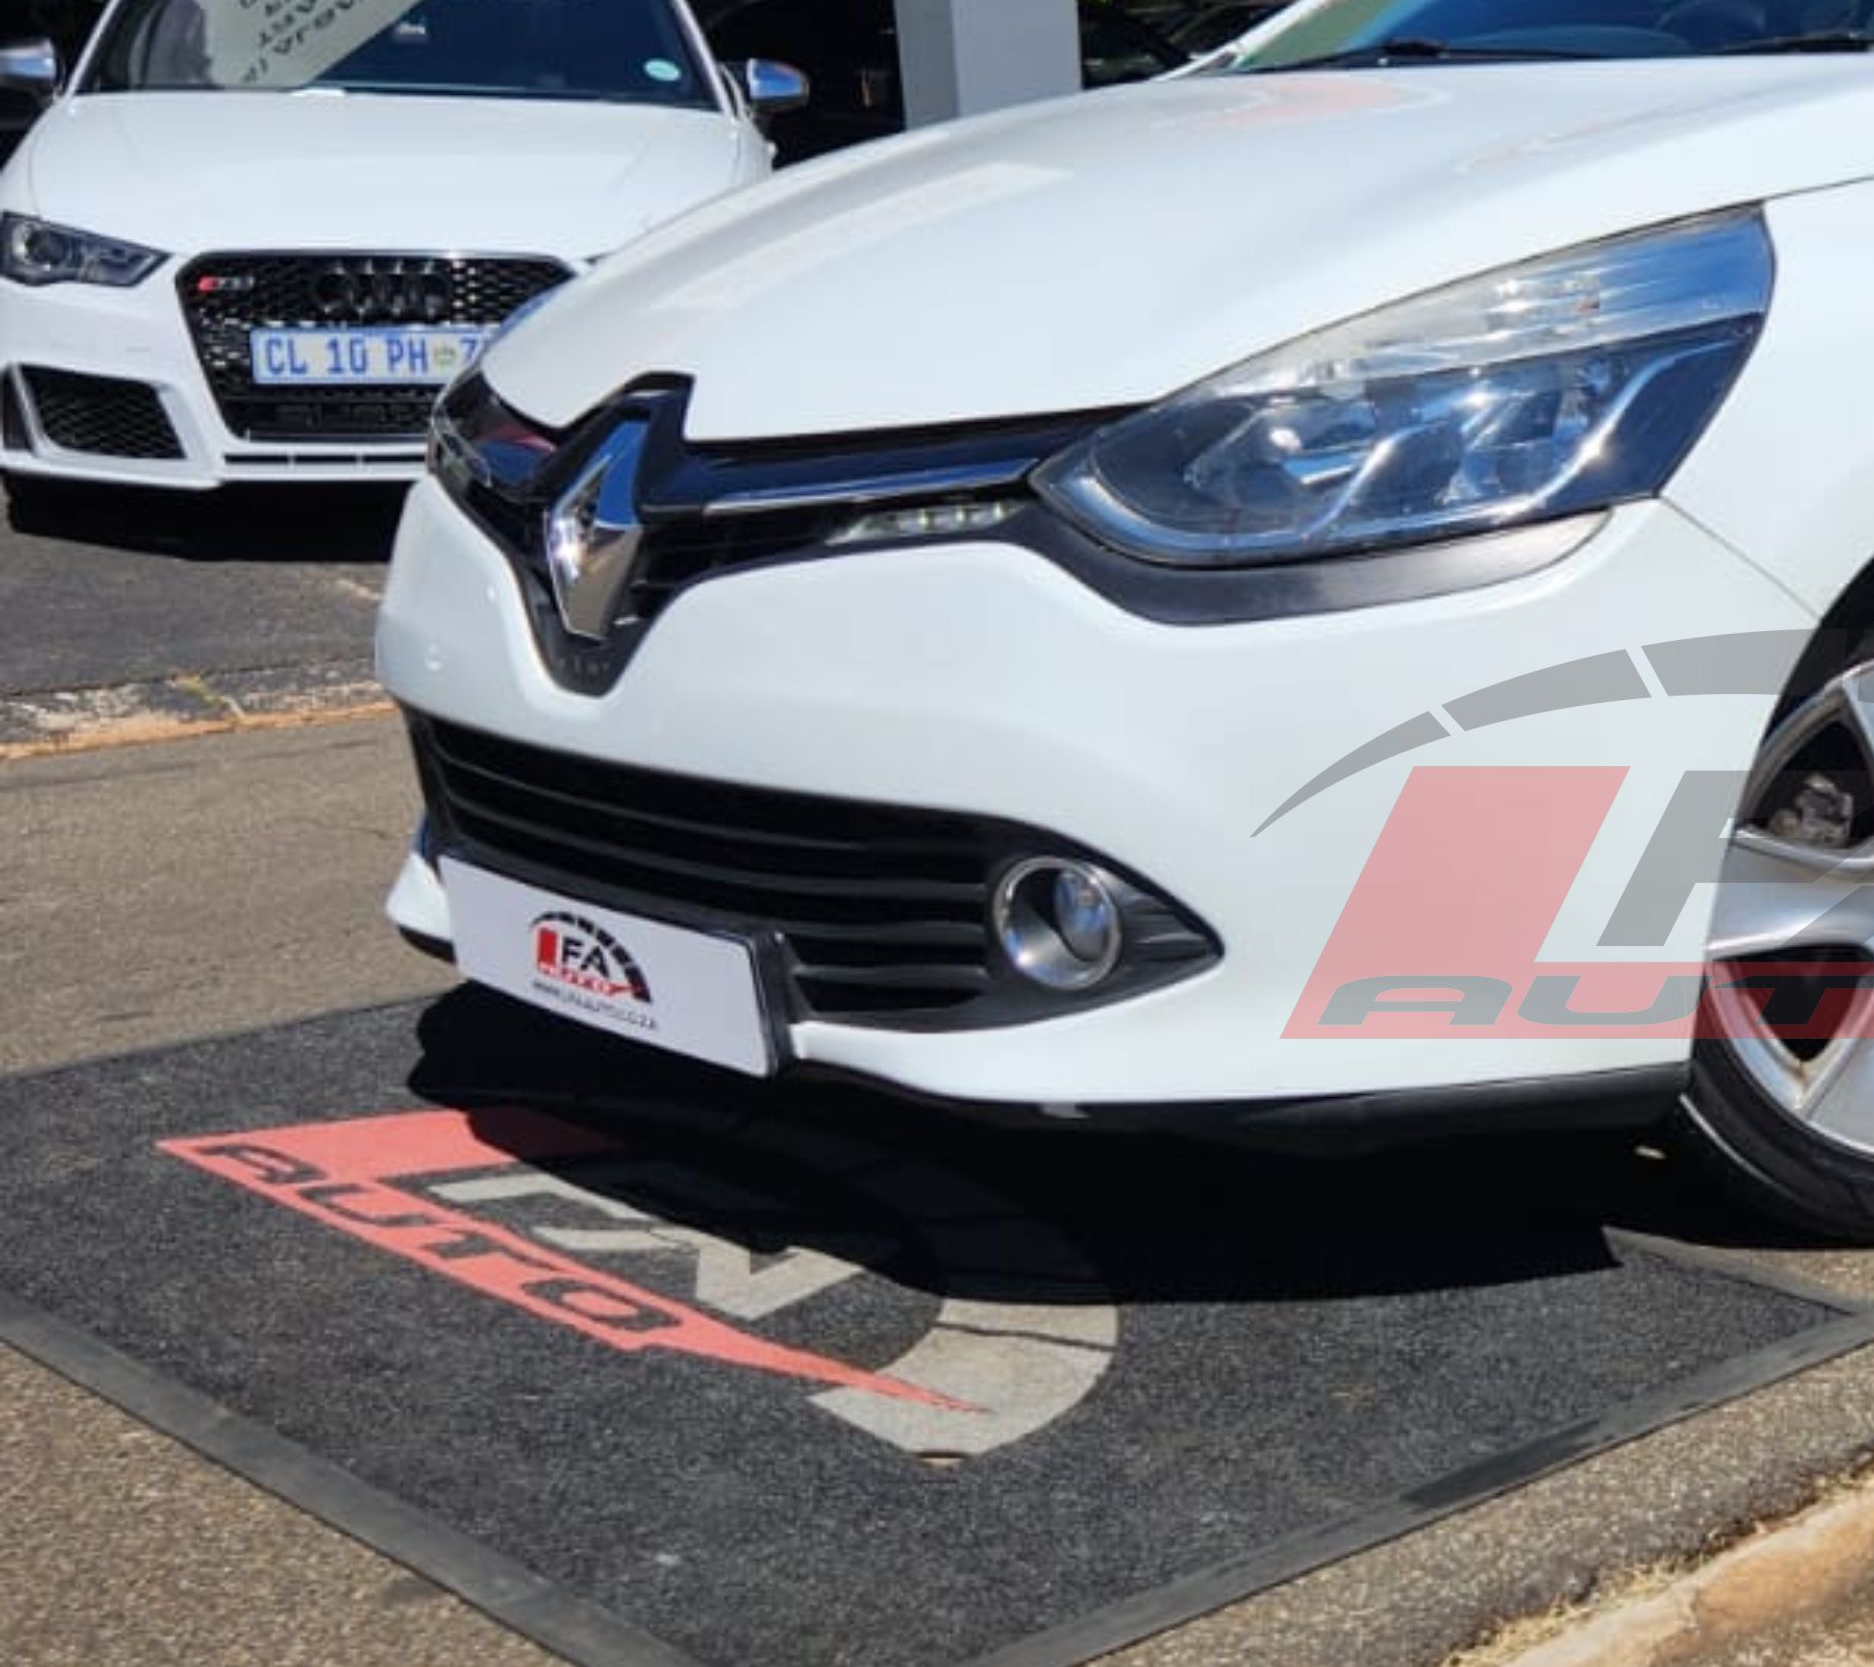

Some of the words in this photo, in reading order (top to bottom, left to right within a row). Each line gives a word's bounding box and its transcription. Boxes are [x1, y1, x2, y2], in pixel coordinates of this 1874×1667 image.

[265, 337, 307, 375] CL
[326, 337, 368, 374] 10
[386, 336, 429, 374] PH
[199, 1144, 683, 1332] AUTO
